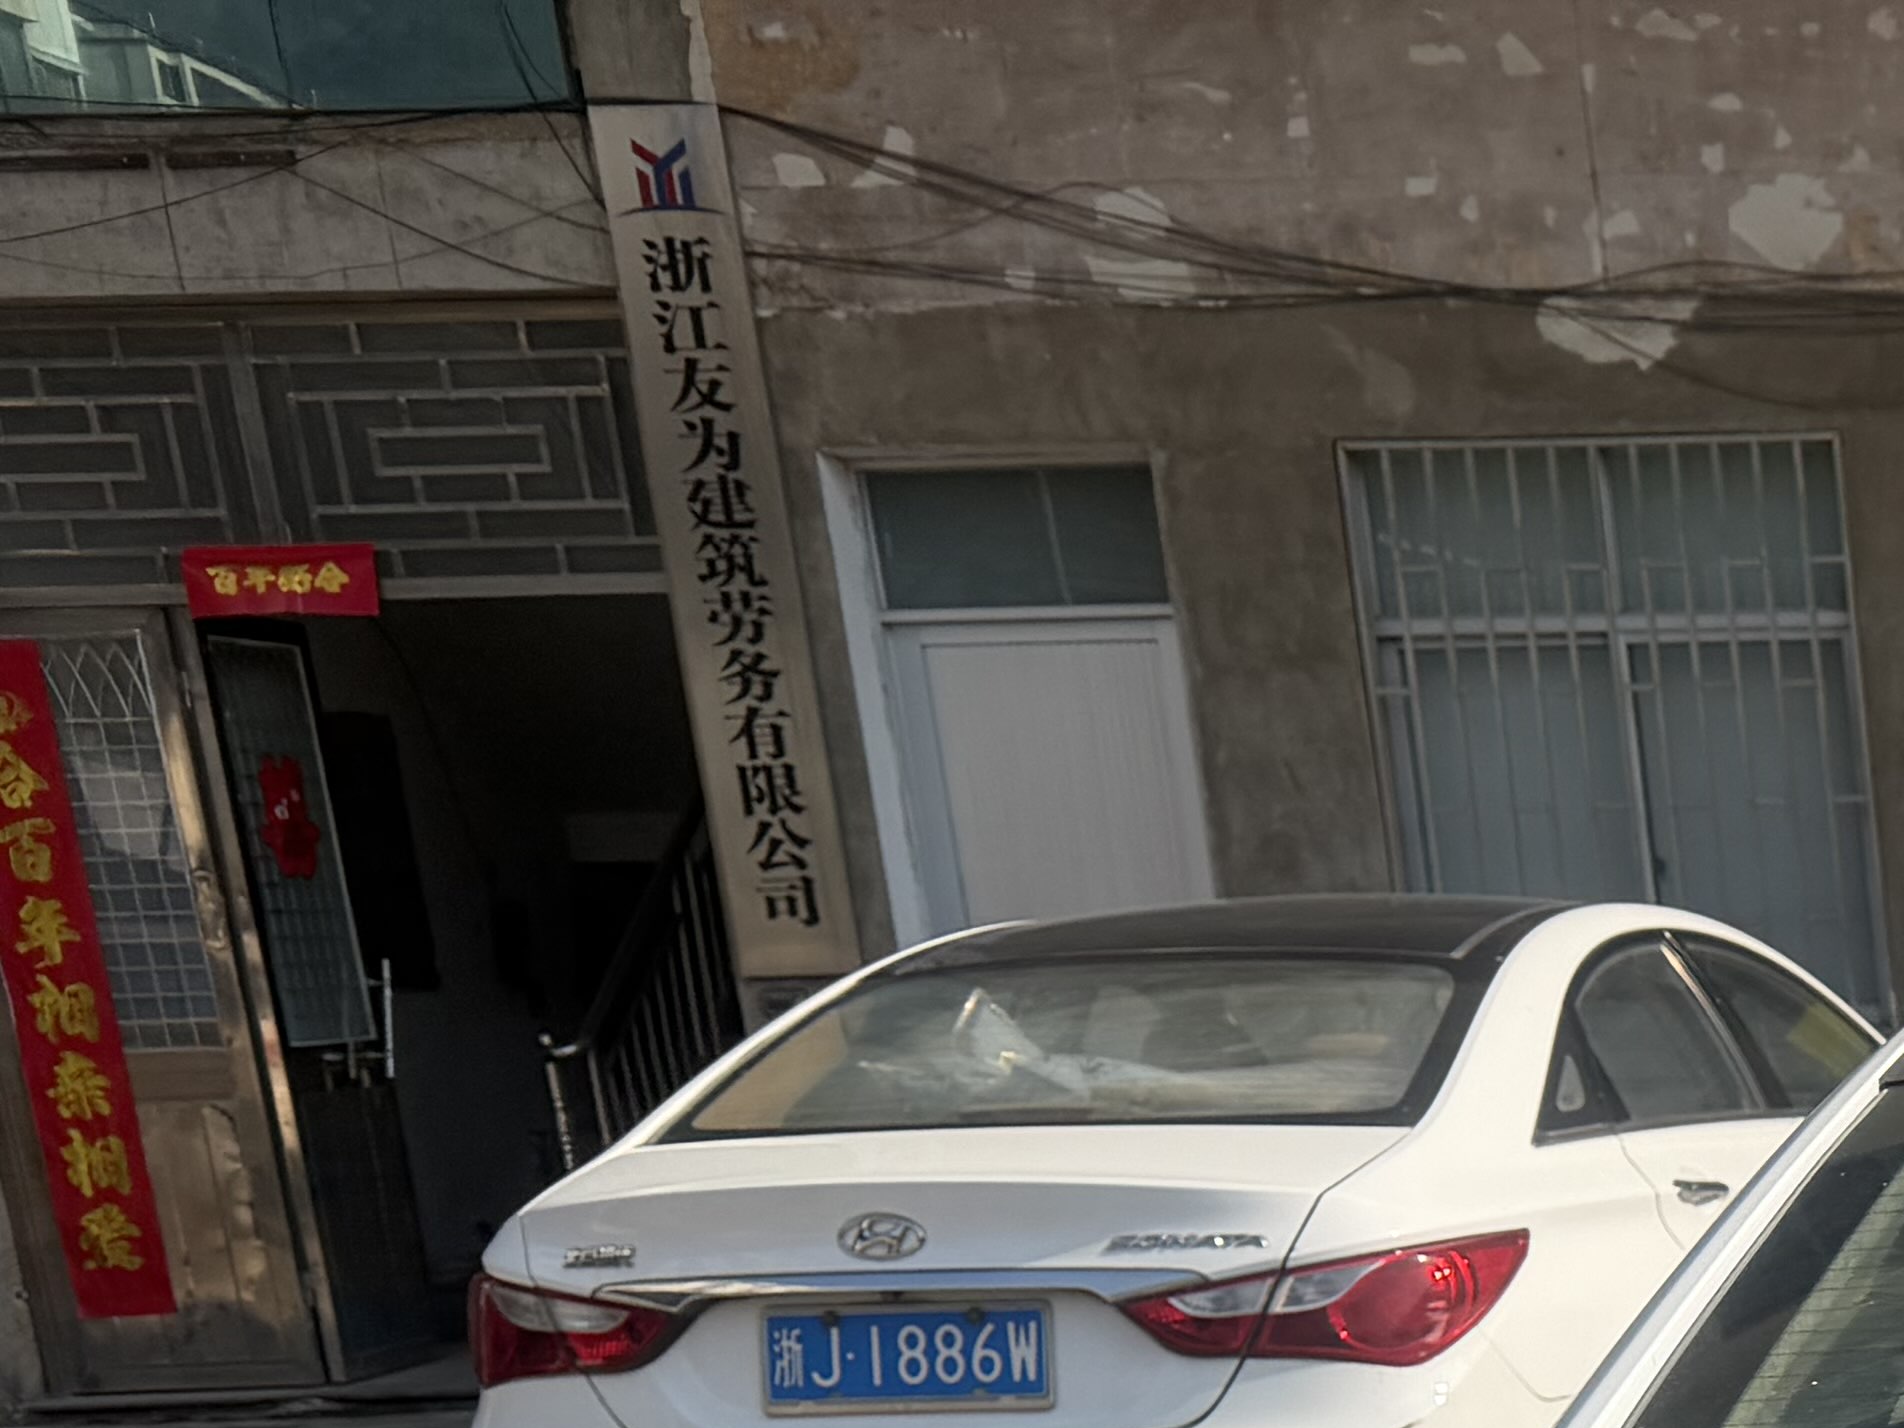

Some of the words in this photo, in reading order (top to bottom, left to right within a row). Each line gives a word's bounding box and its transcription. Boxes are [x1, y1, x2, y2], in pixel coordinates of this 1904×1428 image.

[642, 236, 821, 927] 浙江友为建筑劳务有限公司
[773, 1321, 1038, 1389] 浙J·1886W
